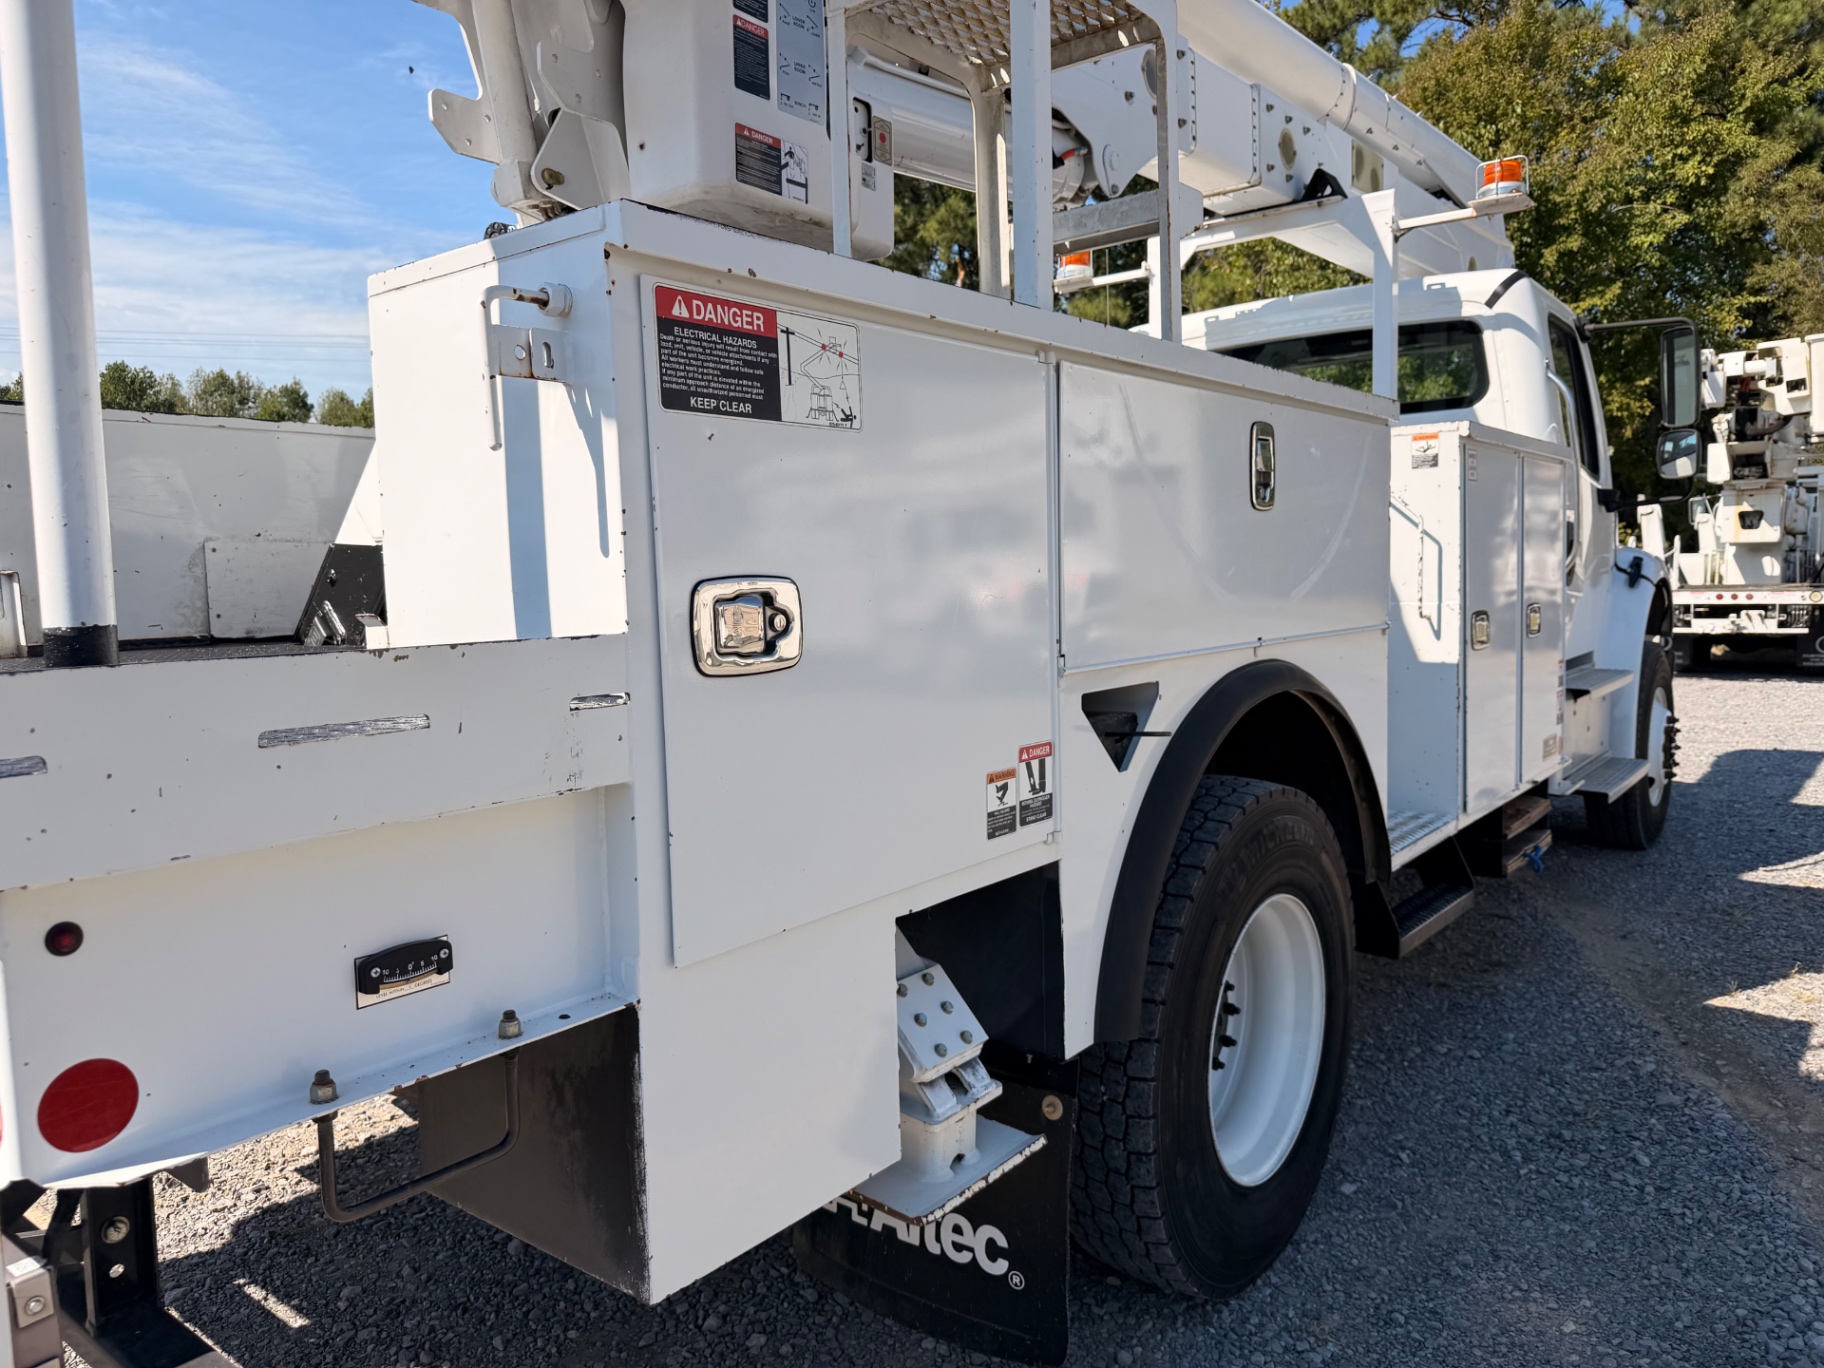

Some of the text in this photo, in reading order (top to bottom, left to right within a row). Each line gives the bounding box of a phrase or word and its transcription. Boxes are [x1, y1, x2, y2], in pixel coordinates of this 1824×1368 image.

[741, 20, 764, 36] DANGER
[752, 131, 773, 144] DANGER
[692, 299, 764, 332] DANGER
[674, 326, 757, 348] ELECTRICAL HAZARDS
[701, 340, 715, 349] injury
[669, 356, 689, 364] workers
[703, 361, 730, 370] understand
[729, 352, 756, 361] attachments
[662, 361, 684, 370] electrical
[698, 366, 721, 376] practices.
[677, 370, 687, 378] part
[662, 375, 685, 383] minimum
[687, 378, 708, 387] approach
[743, 386, 765, 395] energized
[663, 382, 689, 391] conductor,
[697, 386, 728, 395] unauthorized
[729, 391, 751, 399] personnel
[690, 397, 752, 413] KEEP CLEAR
[1030, 746, 1050, 758] DANGER
[995, 770, 1015, 780] WARNING
